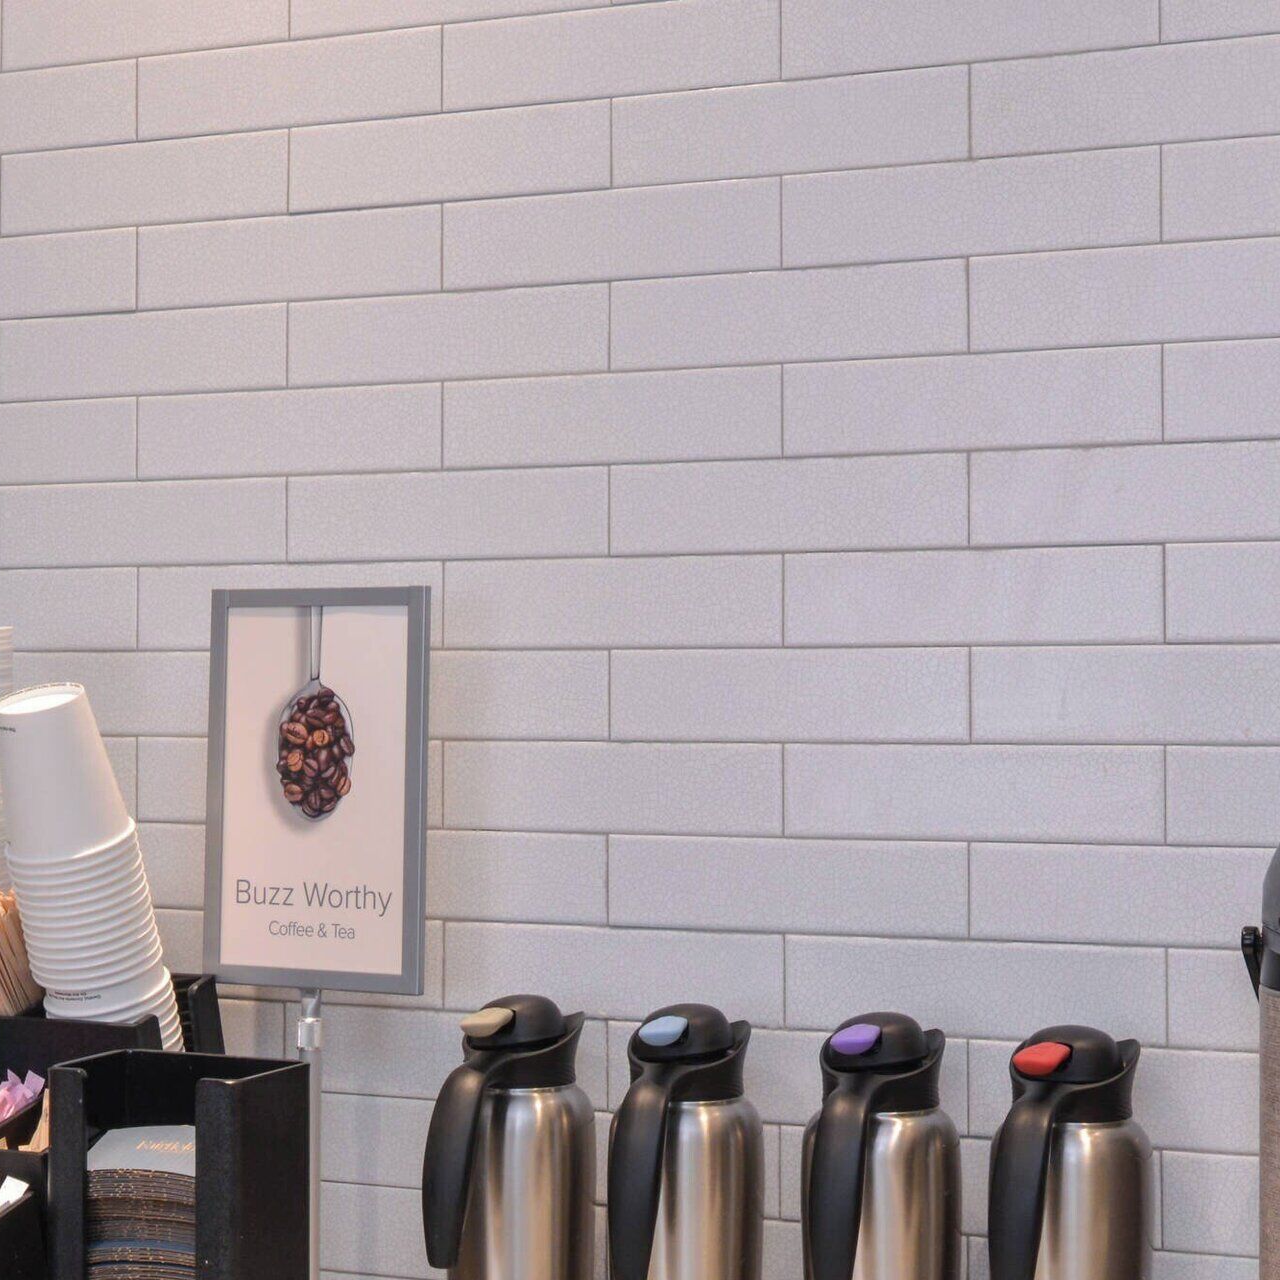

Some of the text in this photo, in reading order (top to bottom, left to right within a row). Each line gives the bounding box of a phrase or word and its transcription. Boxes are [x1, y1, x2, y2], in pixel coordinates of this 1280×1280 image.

[235, 879, 393, 917] Buzz Worthy
[268, 920, 356, 940] Coffee & Tea
